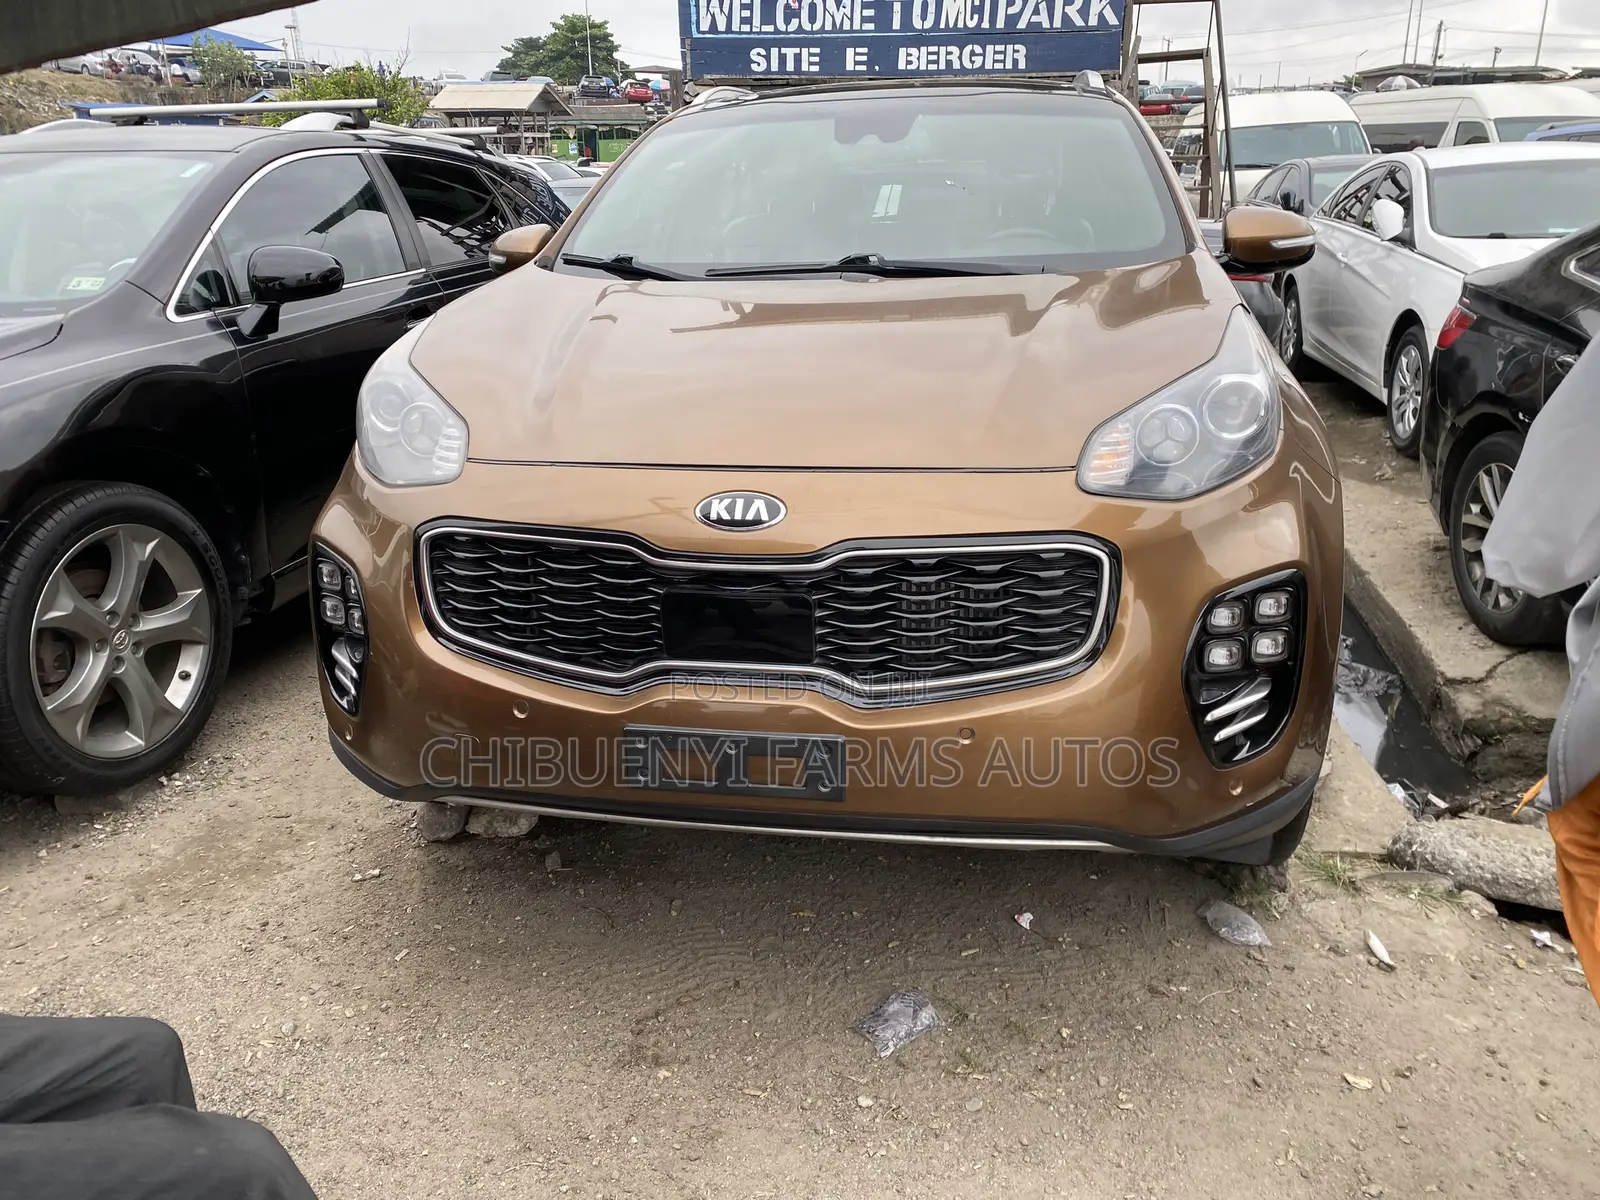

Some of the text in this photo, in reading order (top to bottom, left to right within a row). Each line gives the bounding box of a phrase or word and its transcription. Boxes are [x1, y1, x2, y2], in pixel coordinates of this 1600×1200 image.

[698, 0, 875, 32] WELCOME
[885, 0, 936, 30] TO
[995, 0, 1120, 29] PARK
[749, 47, 821, 72] SITE
[898, 44, 1026, 71] BERGER
[709, 498, 769, 521] KIA
